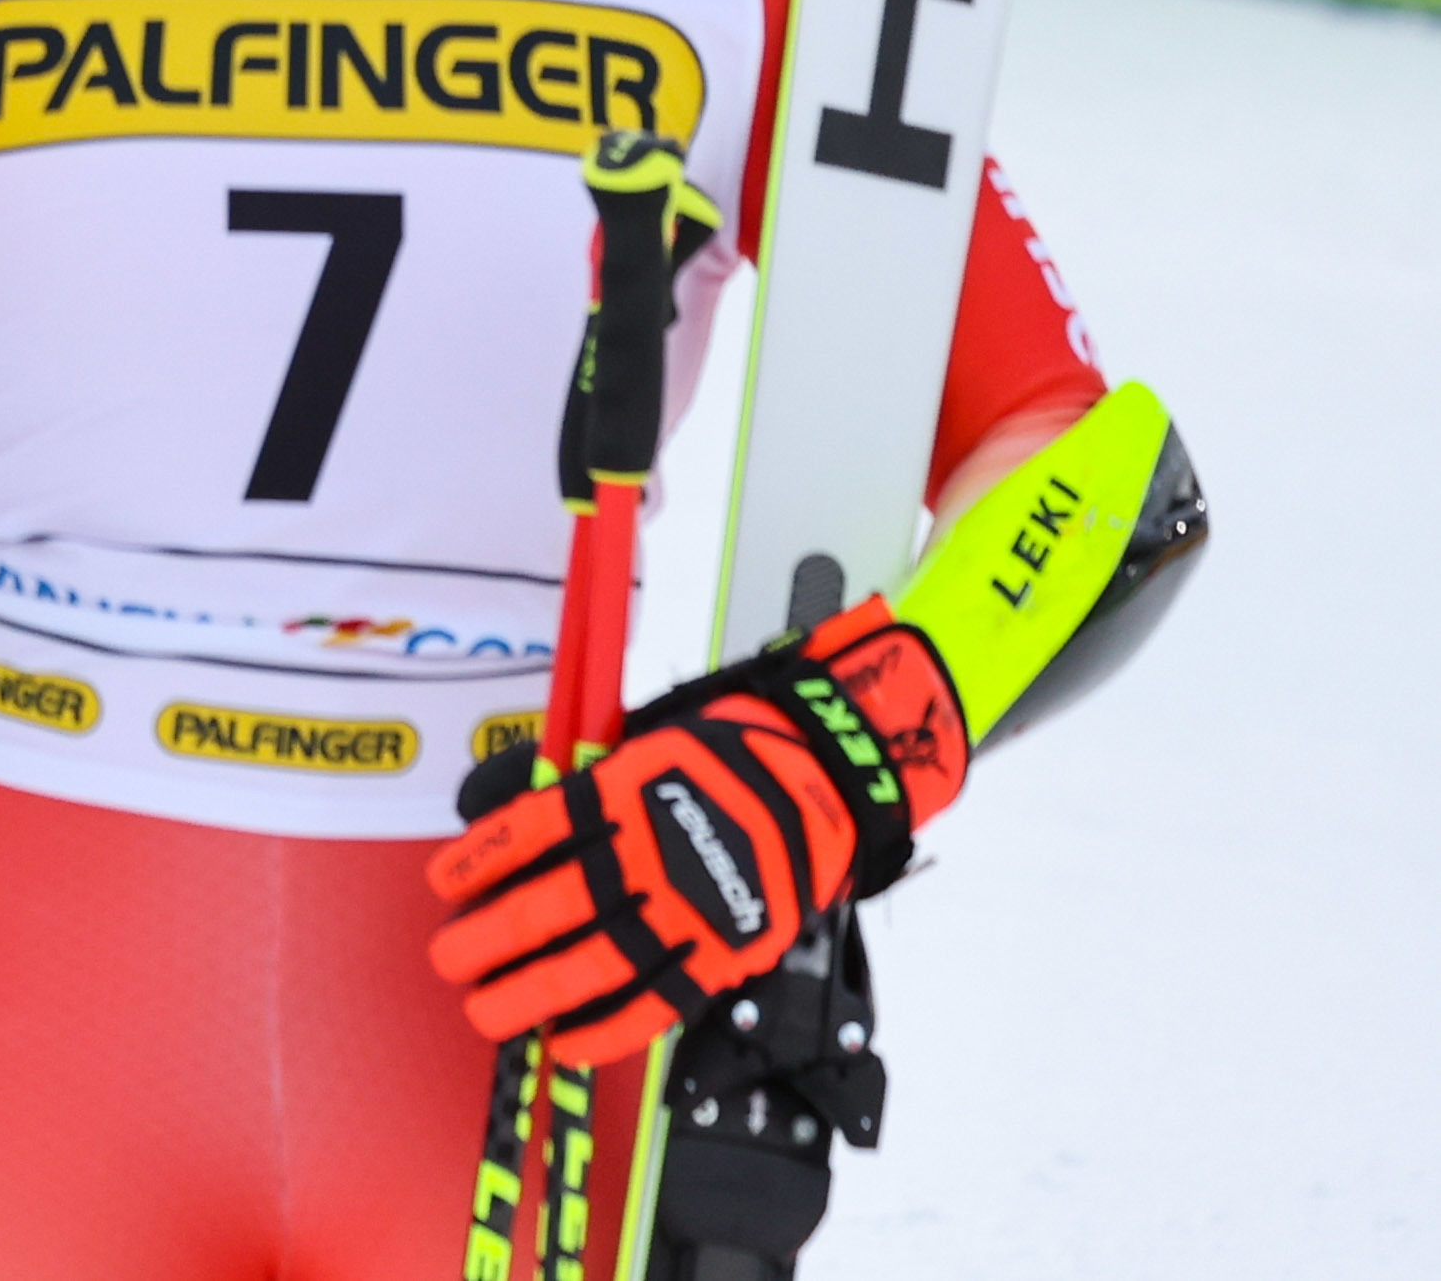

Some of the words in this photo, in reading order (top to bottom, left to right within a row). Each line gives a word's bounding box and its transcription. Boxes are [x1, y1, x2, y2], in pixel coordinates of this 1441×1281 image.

[226, 186, 407, 504] 7
[991, 476, 1083, 610] LEKI
[172, 706, 405, 765] PALFINGER
[793, 678, 900, 805] LEKI
[656, 781, 764, 935] reusch
